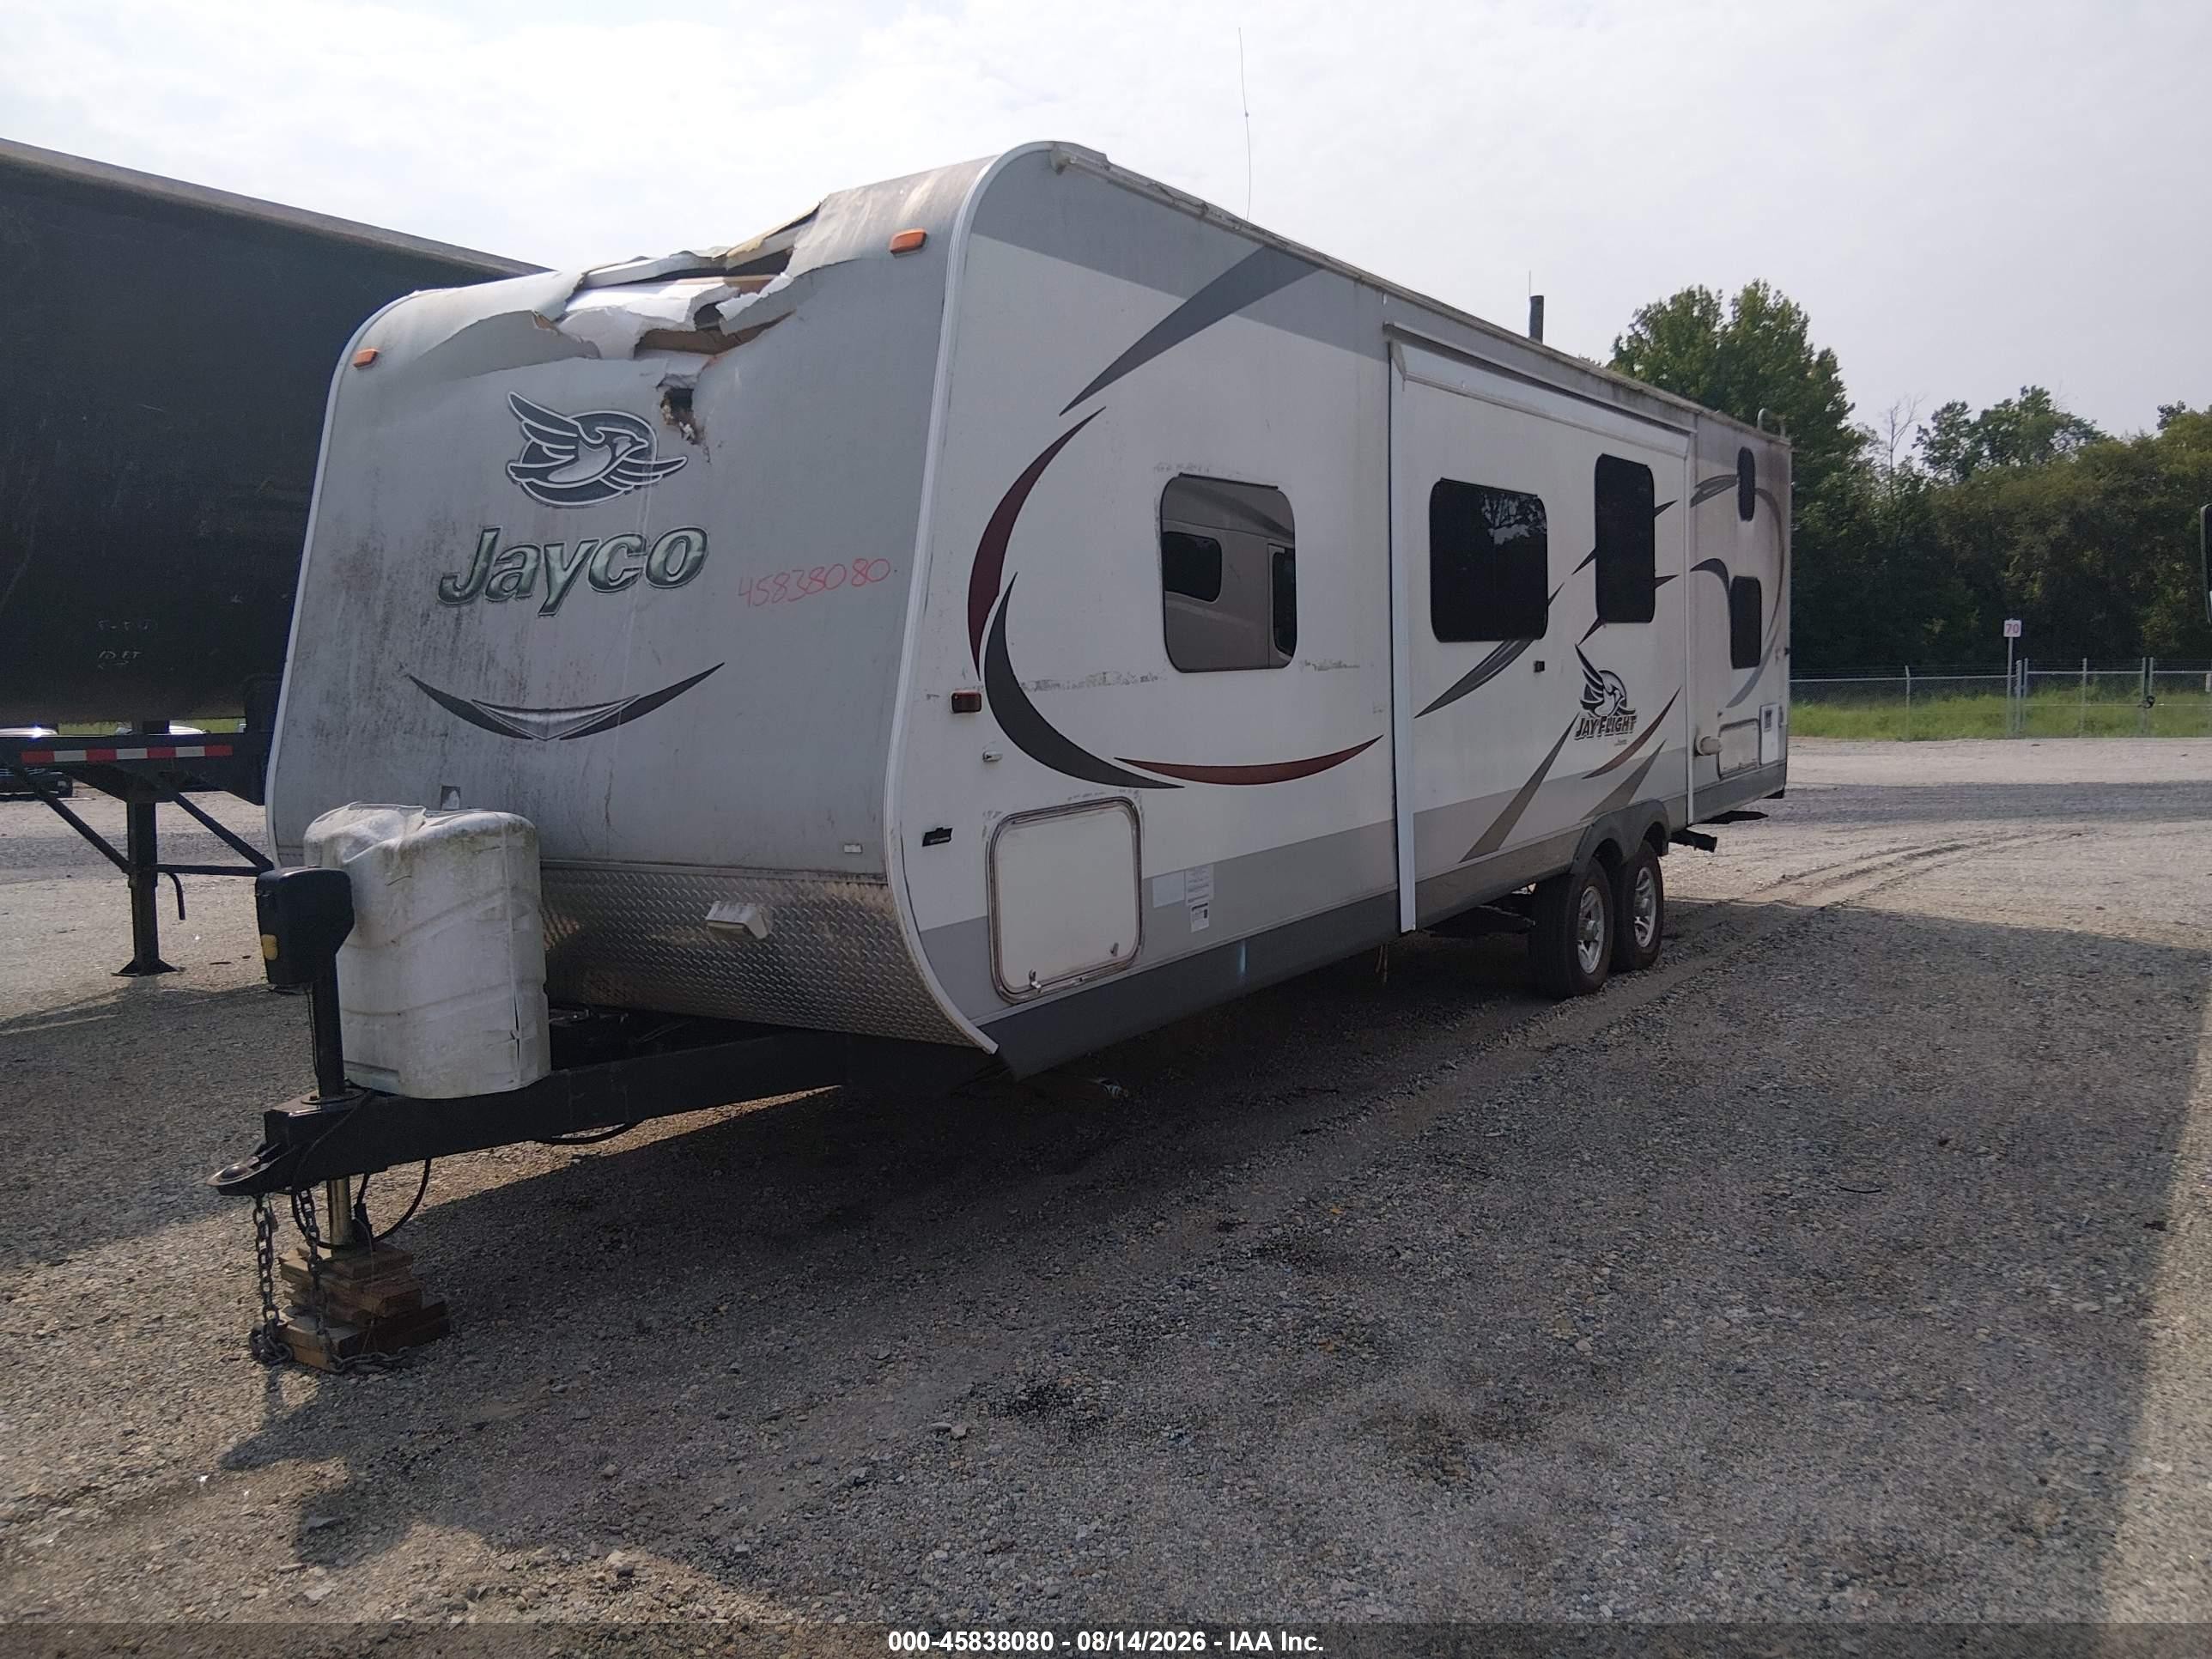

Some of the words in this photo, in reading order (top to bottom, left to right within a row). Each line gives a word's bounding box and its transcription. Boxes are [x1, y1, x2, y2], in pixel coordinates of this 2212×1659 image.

[437, 526, 709, 617] Jayco
[737, 557, 890, 608] 45838080
[2006, 623, 2020, 634] 70
[1575, 717, 1599, 738] JAY
[1598, 715, 1637, 735] FLIGHT
